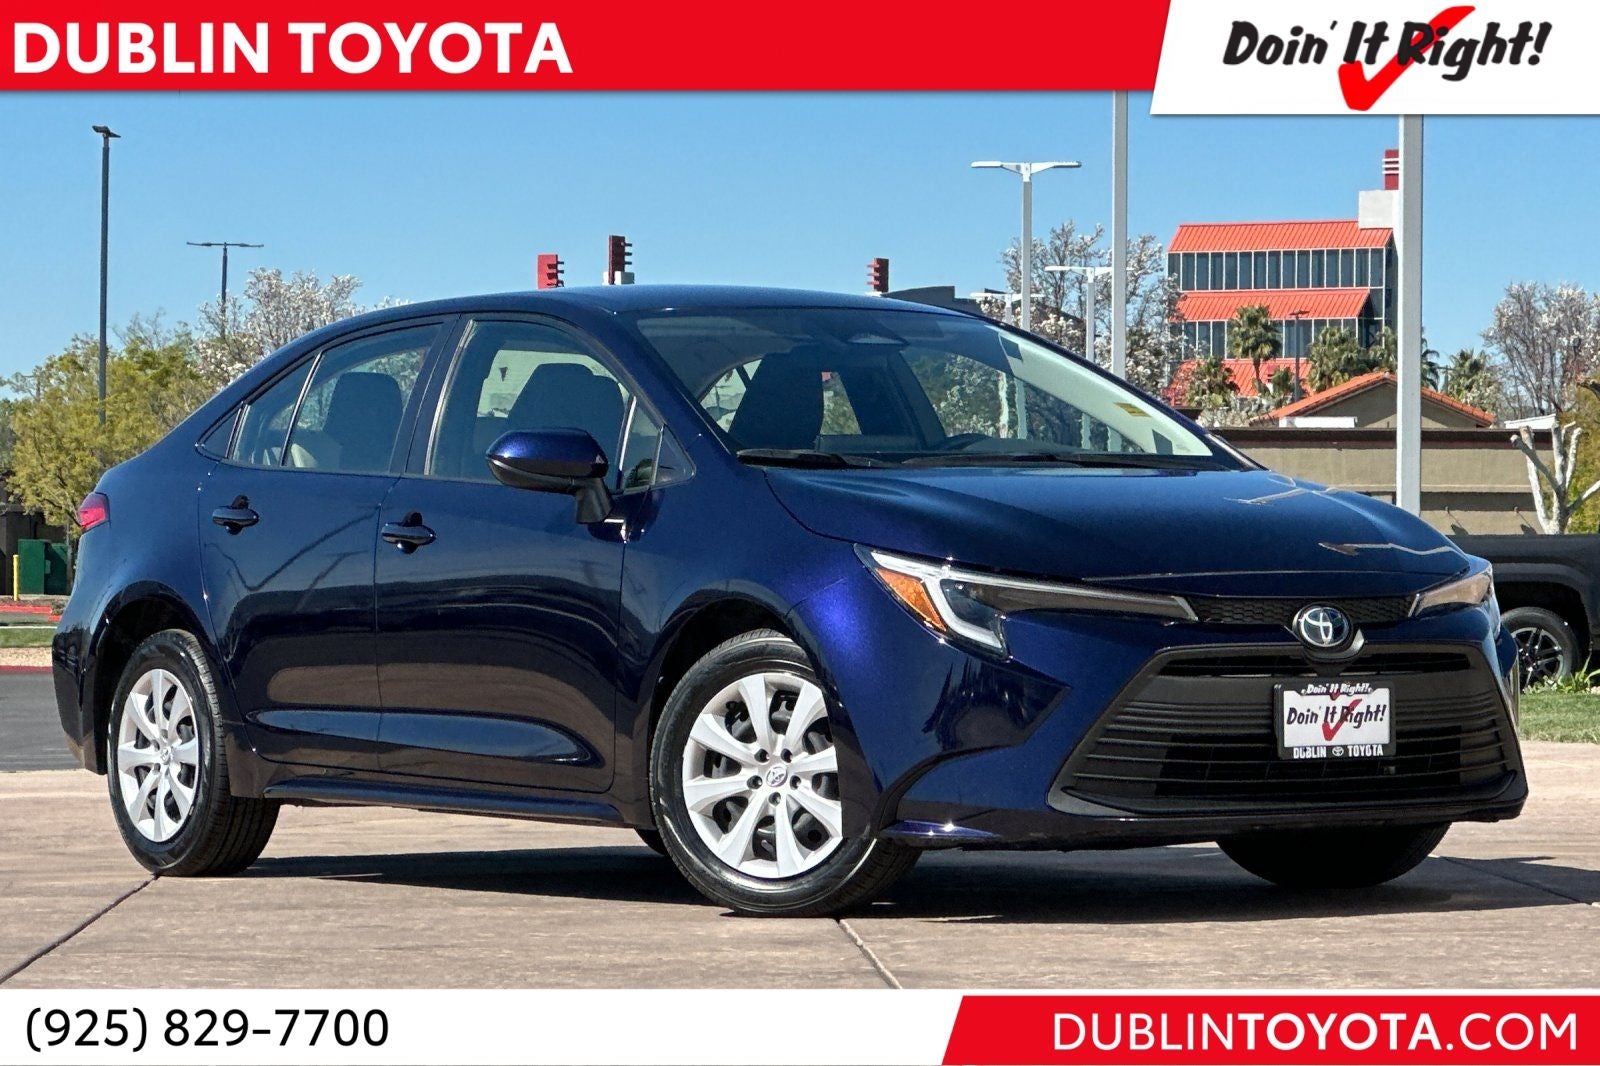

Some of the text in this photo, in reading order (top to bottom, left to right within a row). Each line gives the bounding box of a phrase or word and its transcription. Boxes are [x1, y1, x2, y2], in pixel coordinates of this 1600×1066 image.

[1306, 682, 1370, 696] Doin' It Right!
[1286, 704, 1387, 729] Doin' It Right!
[1293, 744, 1384, 759] DUBLIN TOYOTA
